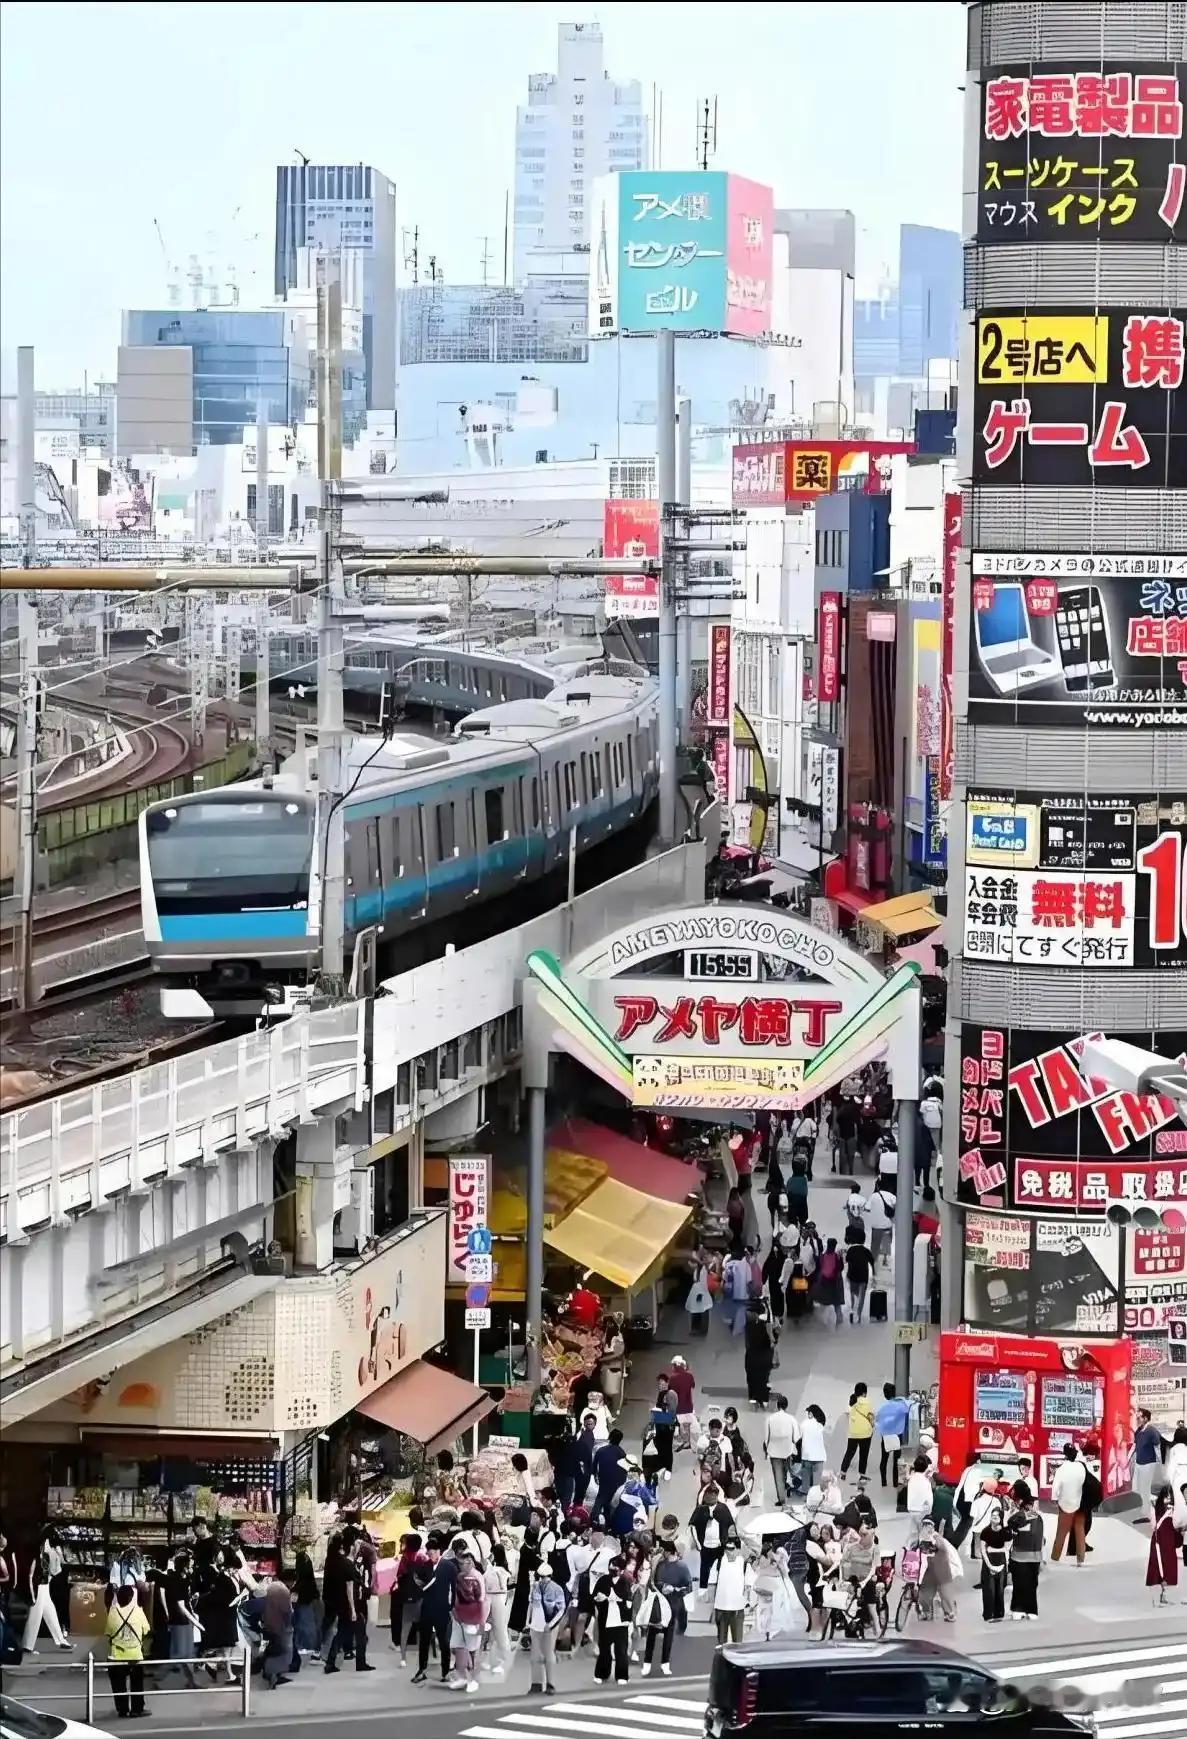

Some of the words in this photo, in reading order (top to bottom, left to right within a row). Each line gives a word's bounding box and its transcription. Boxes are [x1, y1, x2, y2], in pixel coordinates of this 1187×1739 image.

[985, 72, 1183, 140] 家電製品
[984, 155, 1139, 190] スーツケース
[984, 200, 1038, 226] マウス
[1047, 193, 1137, 226] インク
[981, 322, 1097, 379] 2号店へ
[982, 398, 1151, 470] ゲーム
[1031, 879, 1126, 928] 無料
[612, 996, 843, 1047] アメヤ横丁
